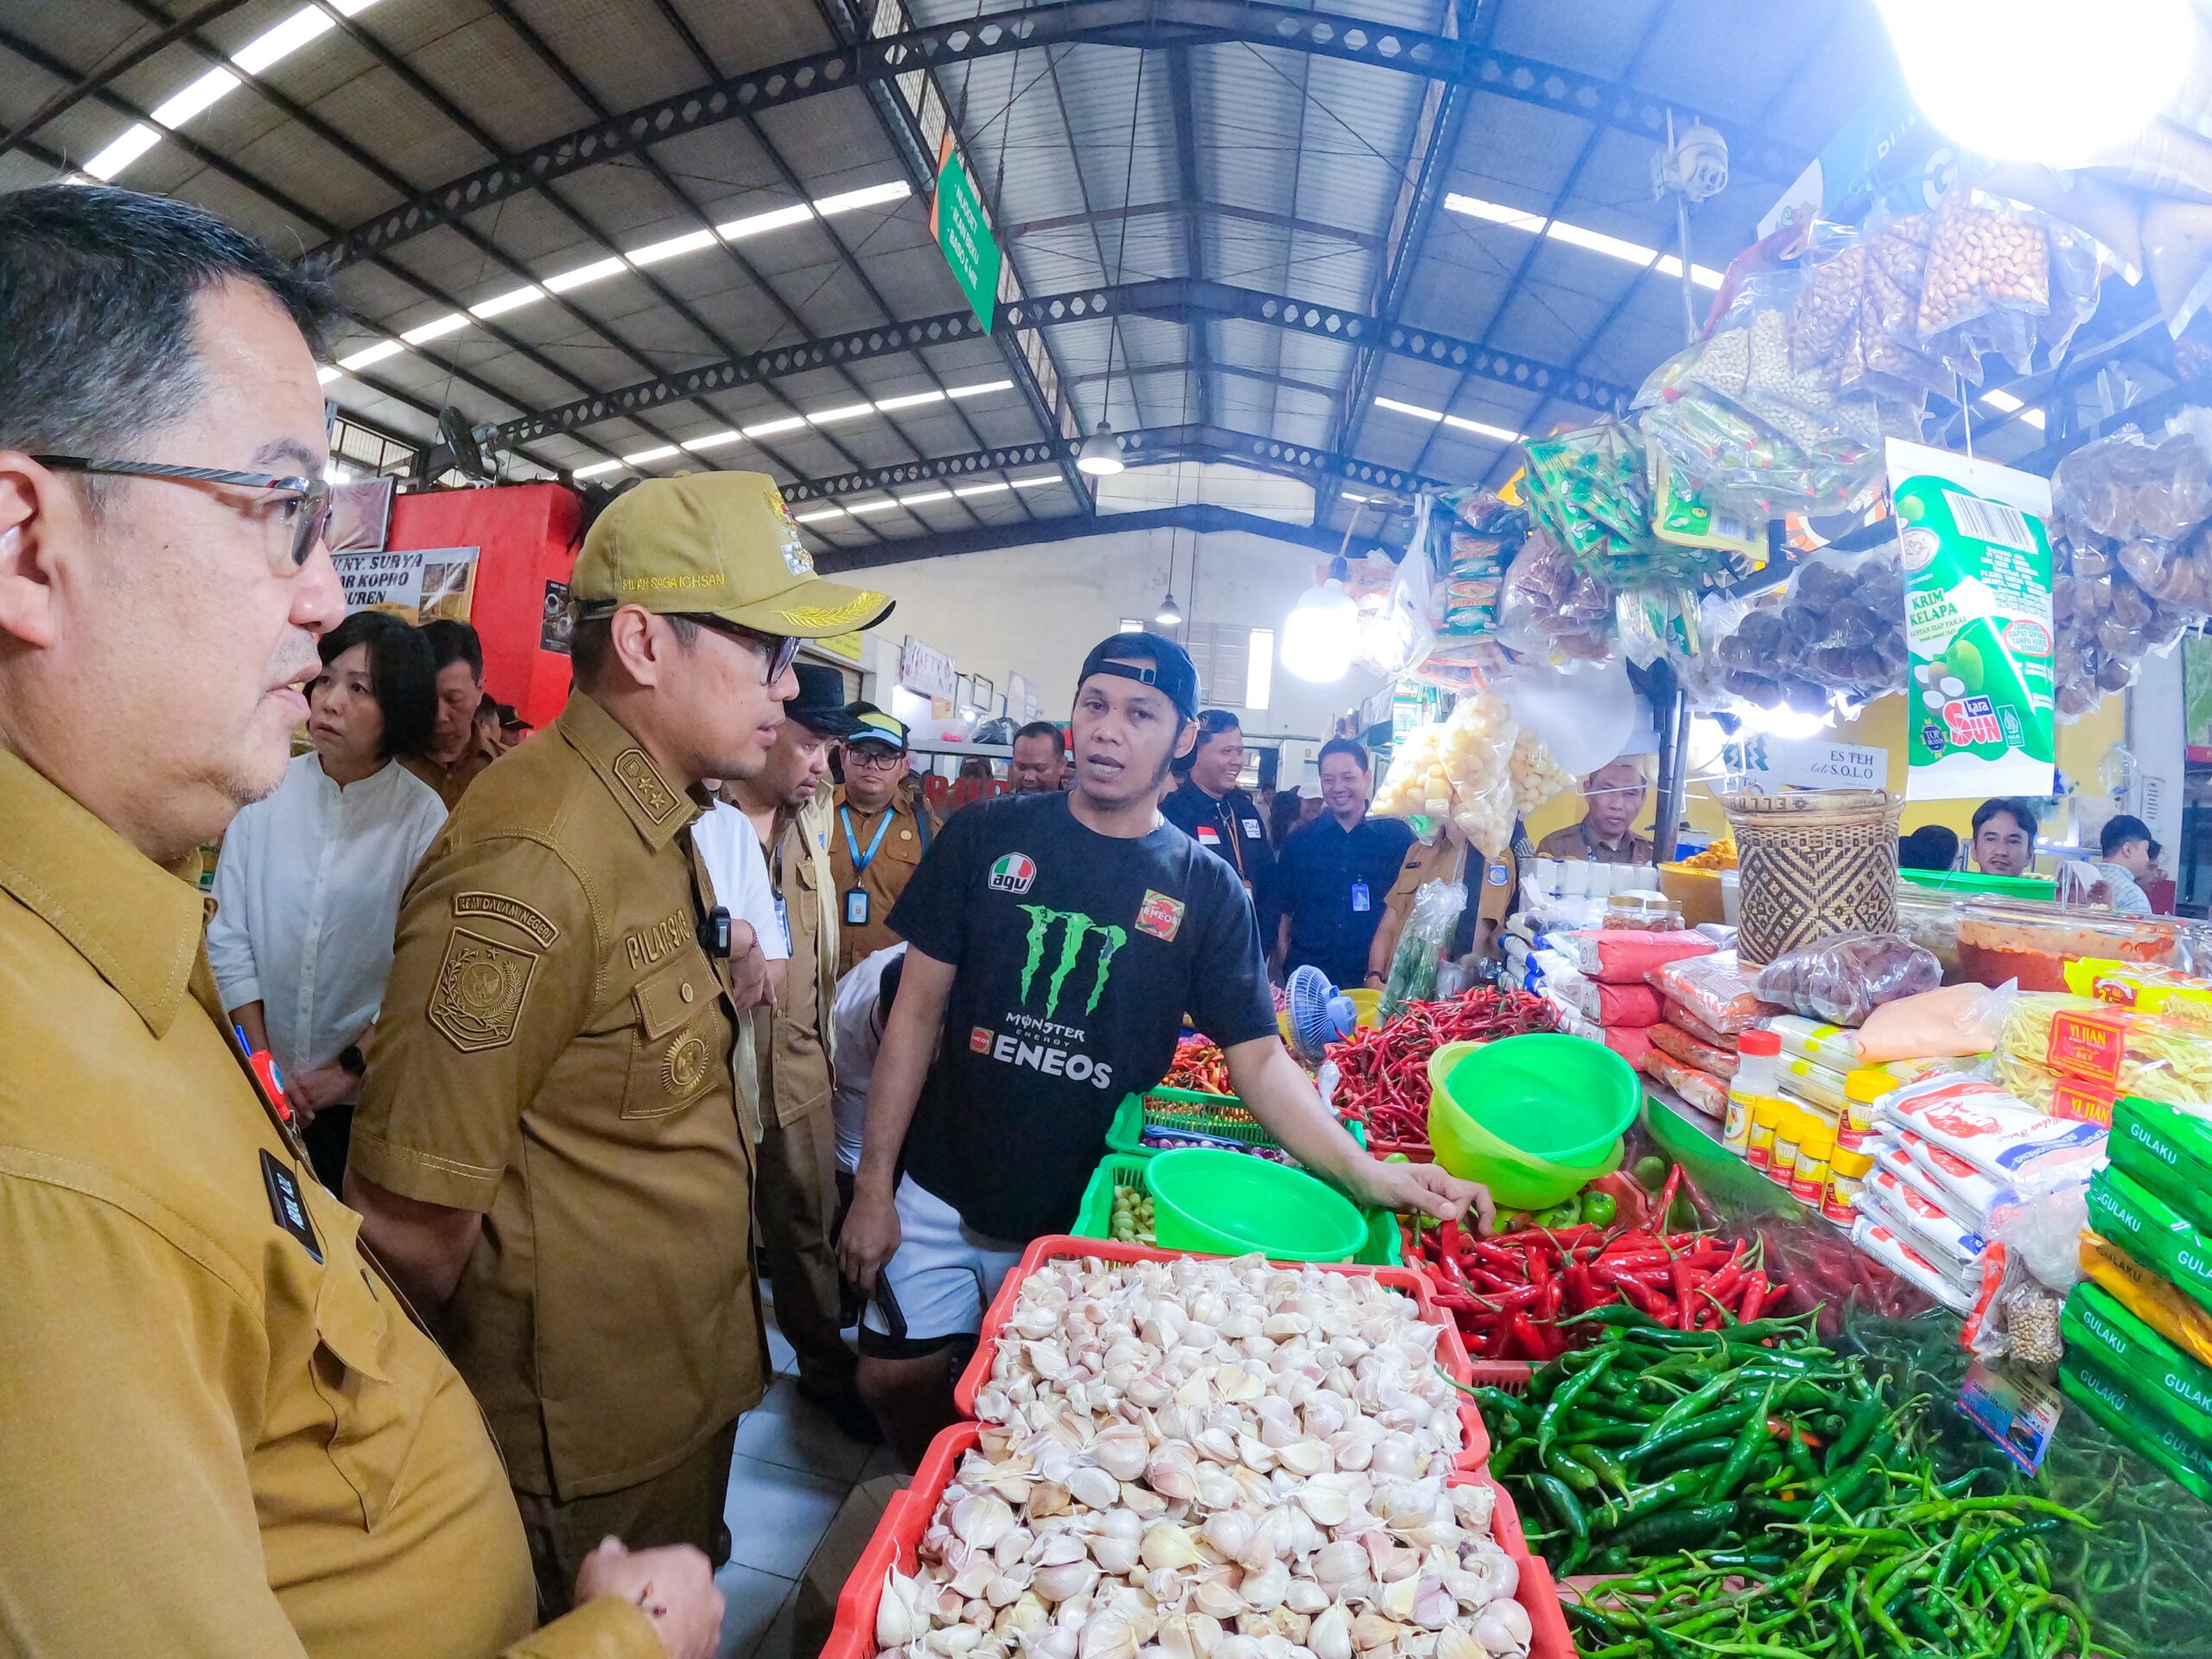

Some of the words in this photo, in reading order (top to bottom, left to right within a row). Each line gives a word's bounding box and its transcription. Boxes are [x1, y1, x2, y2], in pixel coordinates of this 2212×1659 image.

[369, 554, 423, 570] SURYA
[357, 571, 410, 588] KOPRO
[679, 572, 725, 588] ICHSAN
[344, 591, 386, 605] UREN
[1912, 589, 1944, 610] KRIM
[1910, 602, 1959, 626] KELAPA
[1965, 700, 1989, 715] kara
[1923, 729, 1940, 740] TOP
[1831, 750, 1845, 762] ES
[1848, 753, 1873, 766] TEH
[993, 874, 1027, 891] agv
[482, 898, 519, 917] DALAM
[519, 910, 551, 941] NEGERI
[1143, 906, 1178, 925] ENEOS
[626, 922, 674, 969] PILAR
[1006, 1012, 1085, 1042] MONSTER
[1015, 1028, 1071, 1047] ENERGY
[2069, 1023, 2080, 1039] YI
[2082, 1027, 2106, 1046] JIAN
[993, 1034, 1113, 1090] ENEOS
[2071, 1096, 2082, 1113] YI
[2083, 1102, 2109, 1123] JIAN
[2130, 1123, 2177, 1165] GULAKU
[2101, 1192, 2141, 1233] GULAKU
[2095, 1246, 2142, 1283] GULAKU
[2083, 1310, 2126, 1354] GULAKU
[2080, 1368, 2126, 1411] GULAKU
